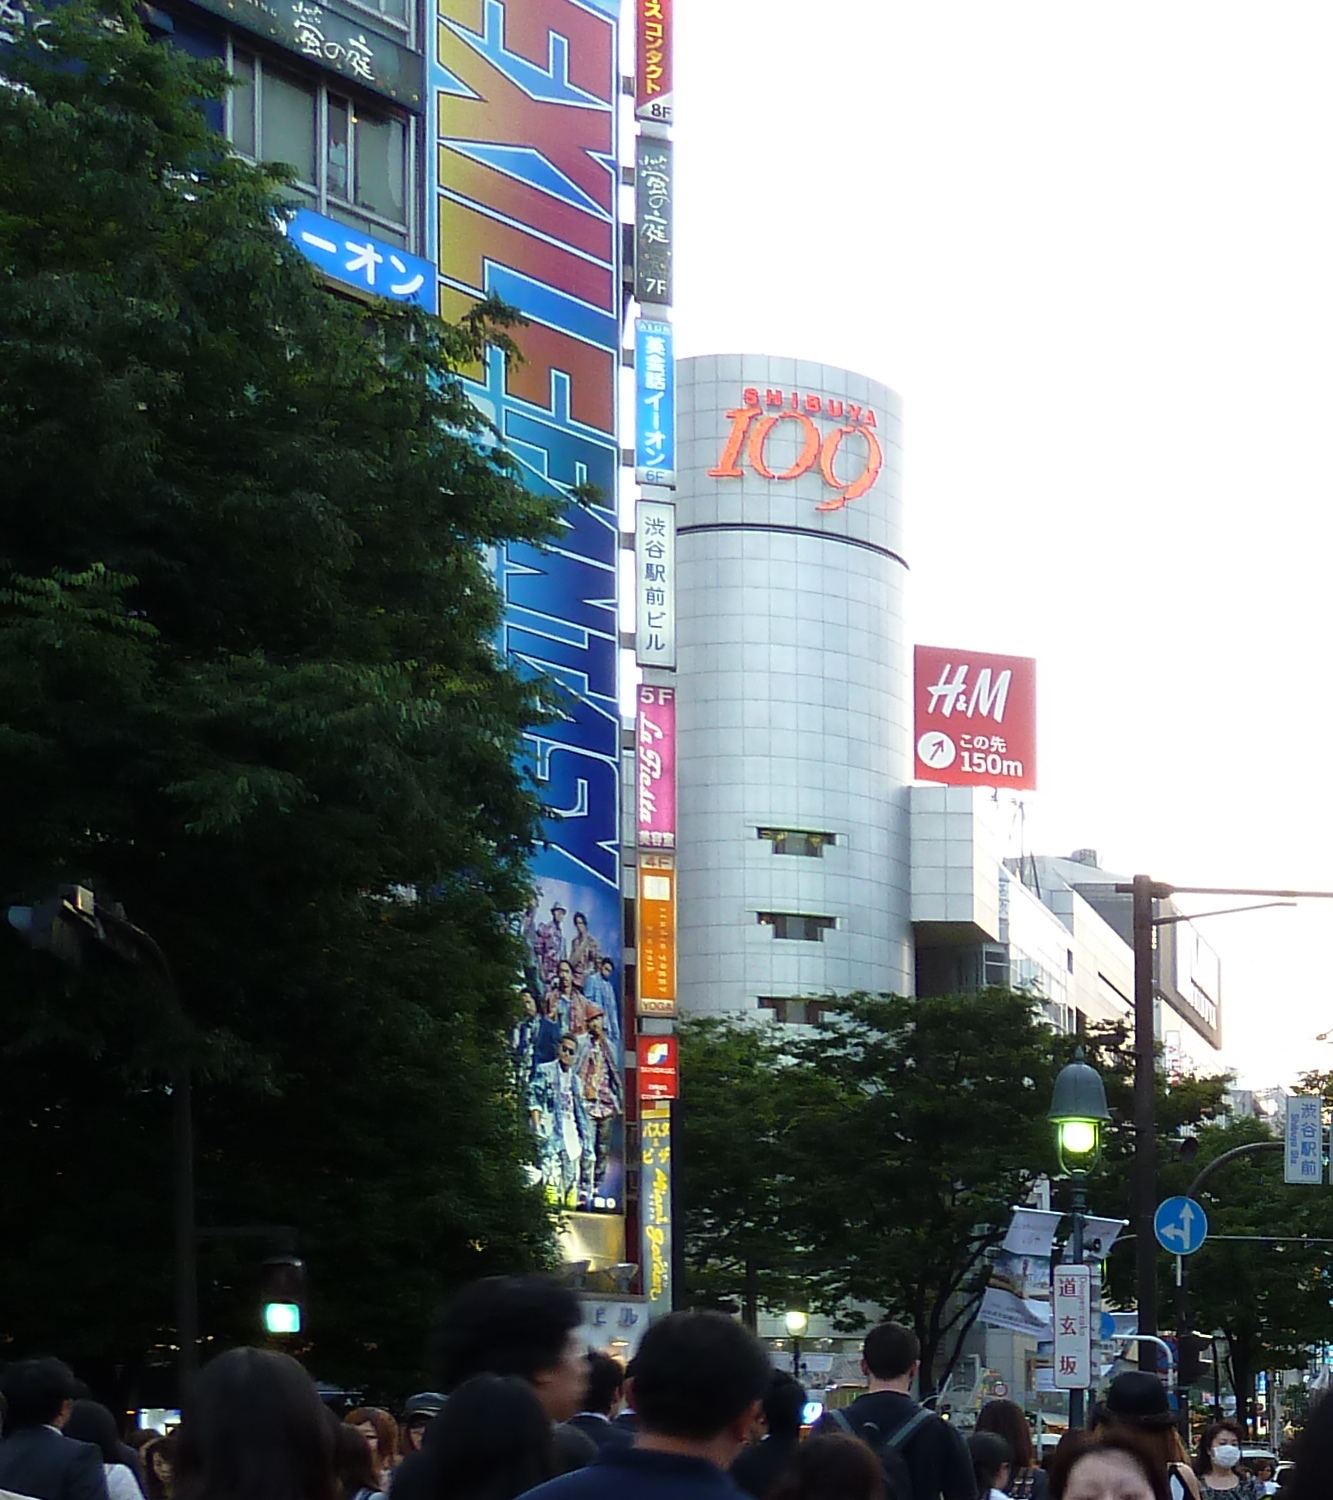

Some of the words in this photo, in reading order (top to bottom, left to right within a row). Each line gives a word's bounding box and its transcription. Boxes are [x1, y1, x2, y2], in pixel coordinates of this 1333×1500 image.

[644, 0, 664, 94] スコンタクト
[651, 104, 671, 118] 8F
[646, 278, 668, 294] 7F
[743, 387, 879, 428] SHIBUYA
[646, 470, 665, 482] 6F
[707, 407, 884, 511] 109
[644, 516, 666, 652] 渋谷駅前ビル
[640, 689, 674, 704] 5F
[927, 663, 1012, 723] H&M
[959, 733, 1008, 753] この先
[960, 752, 1023, 777] 150m
[1301, 1103, 1317, 1175] 渋谷駅前
[1059, 1277, 1077, 1375] 道玄坂
